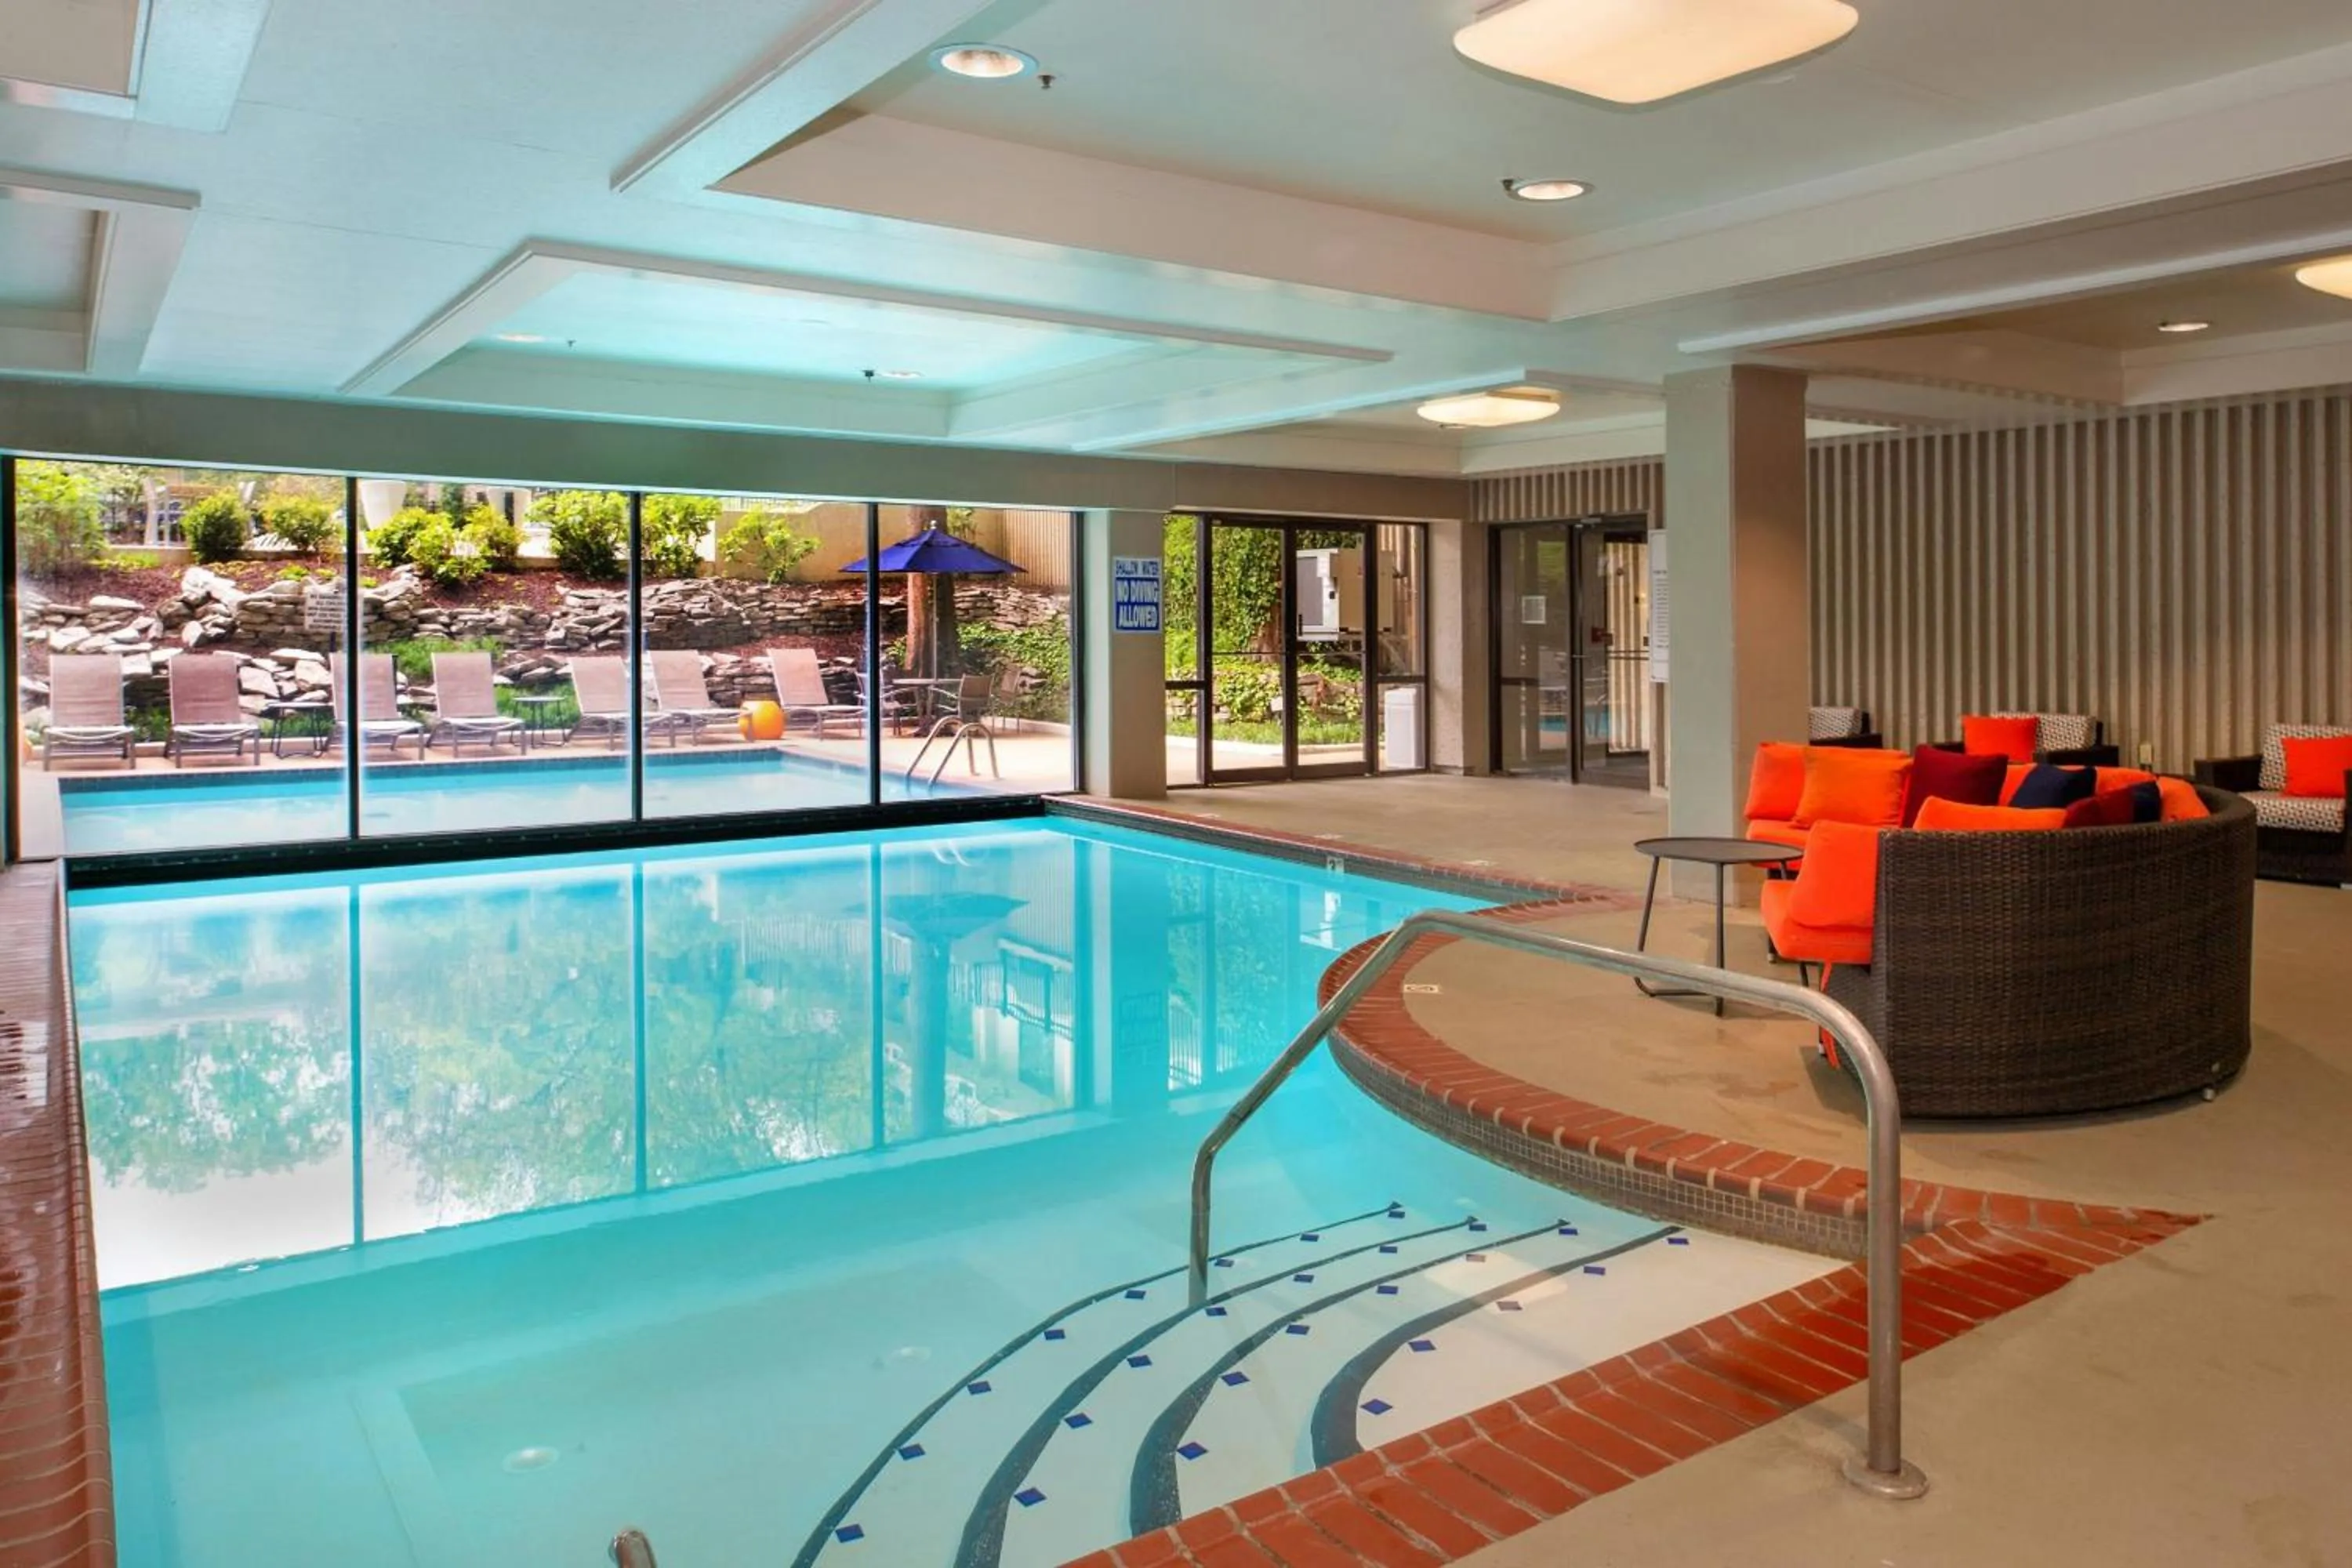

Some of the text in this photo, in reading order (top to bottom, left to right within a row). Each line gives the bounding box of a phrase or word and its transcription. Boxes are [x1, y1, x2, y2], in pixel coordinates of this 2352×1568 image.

[1116, 580, 1158, 603] NO DIVING
[1118, 605, 1158, 628] ALLOWED
